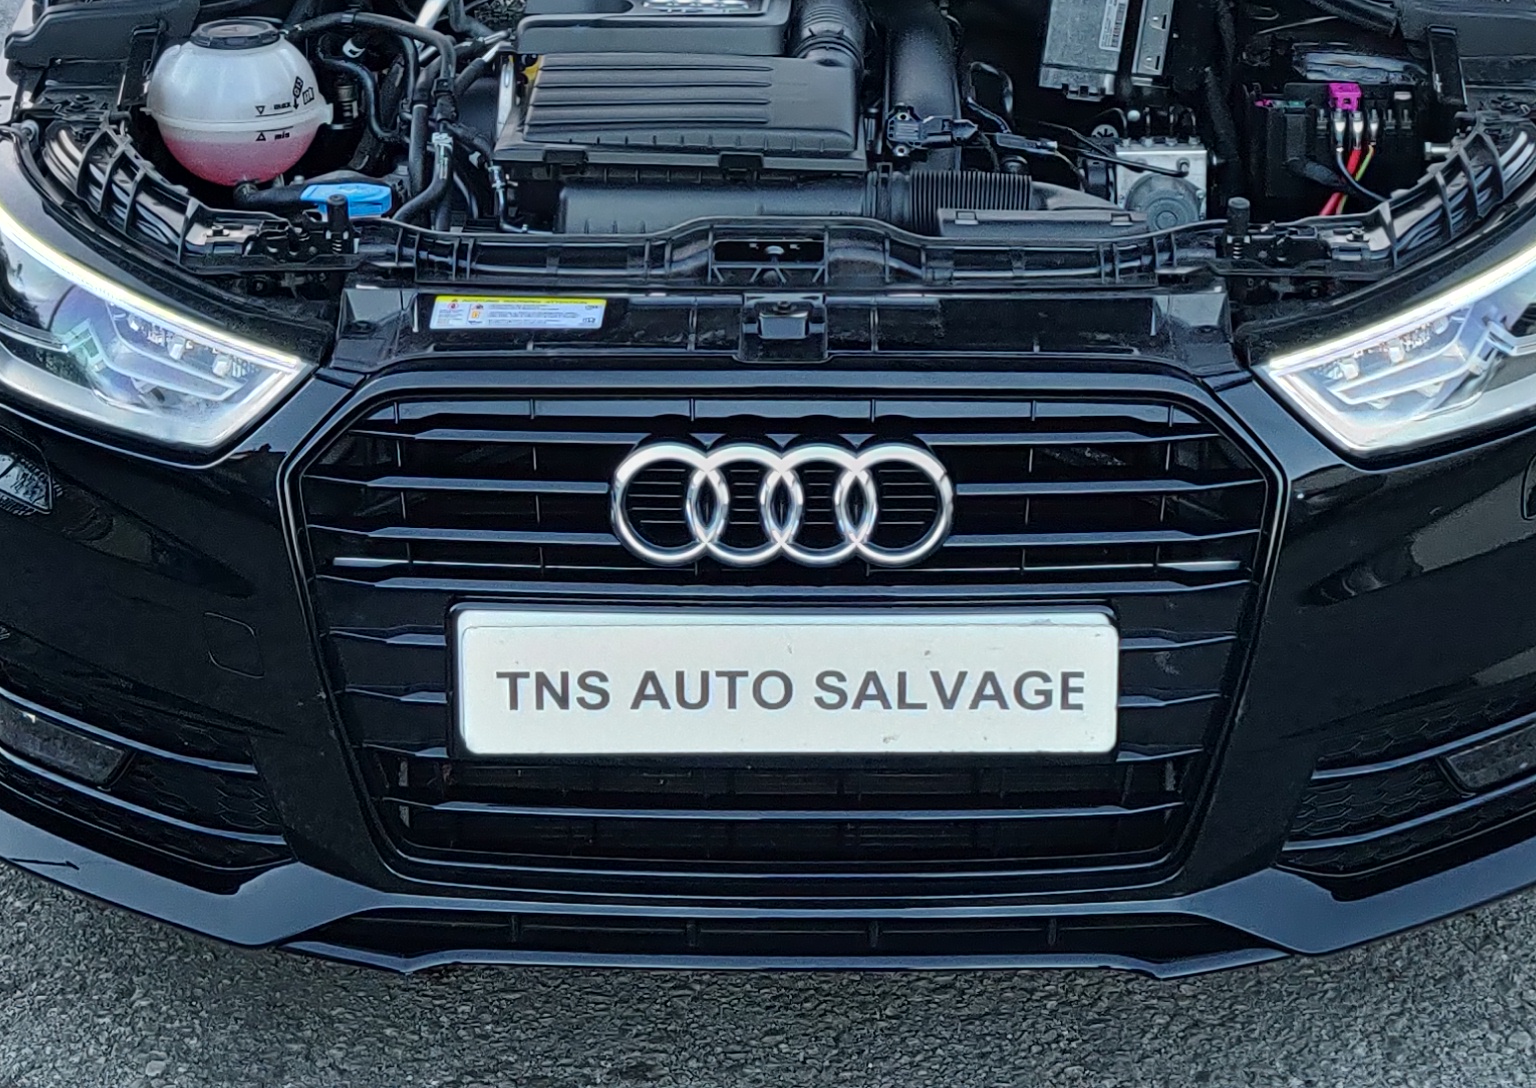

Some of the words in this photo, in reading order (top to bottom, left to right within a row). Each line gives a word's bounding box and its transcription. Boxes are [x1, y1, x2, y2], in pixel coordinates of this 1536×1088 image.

[495, 669, 612, 712] TNS
[629, 669, 794, 712] AUTO
[813, 669, 1085, 712] SALVAGE
